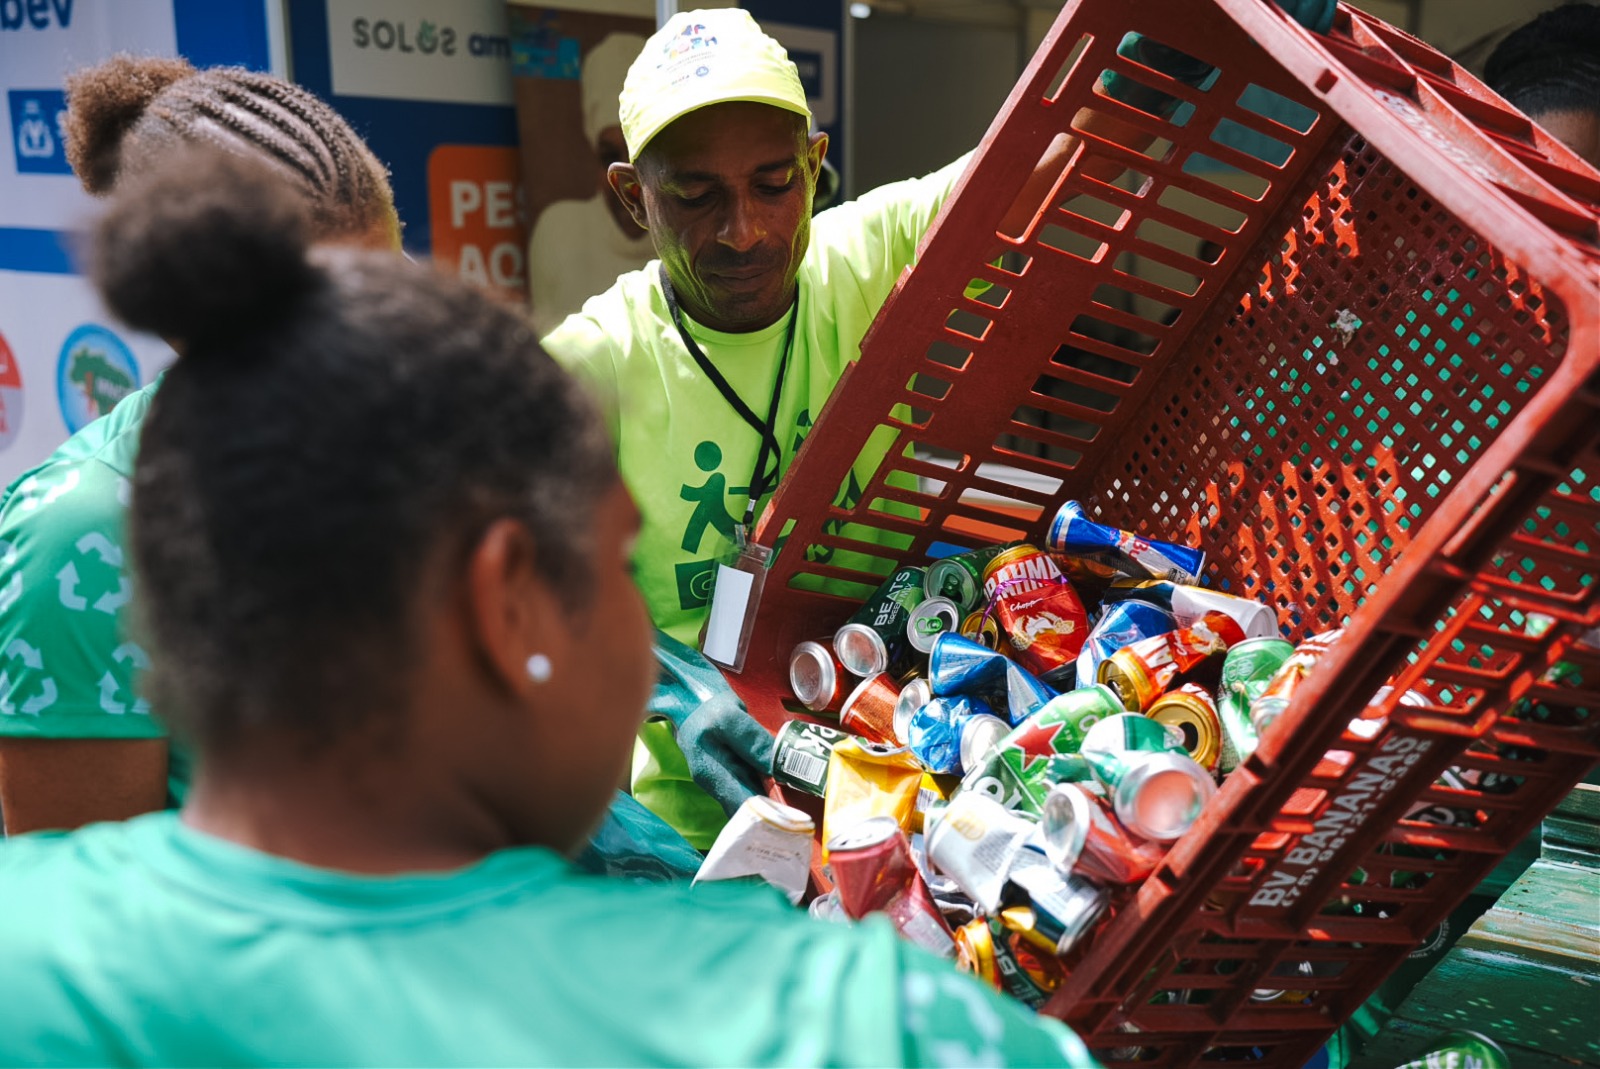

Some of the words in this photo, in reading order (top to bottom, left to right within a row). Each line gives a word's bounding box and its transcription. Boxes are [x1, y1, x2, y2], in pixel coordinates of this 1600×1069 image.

[873, 571, 911, 626] BEATS
[1010, 597, 1043, 612] Chopp
[1248, 870, 1297, 907] BV
[1283, 735, 1417, 866] BANANAS
